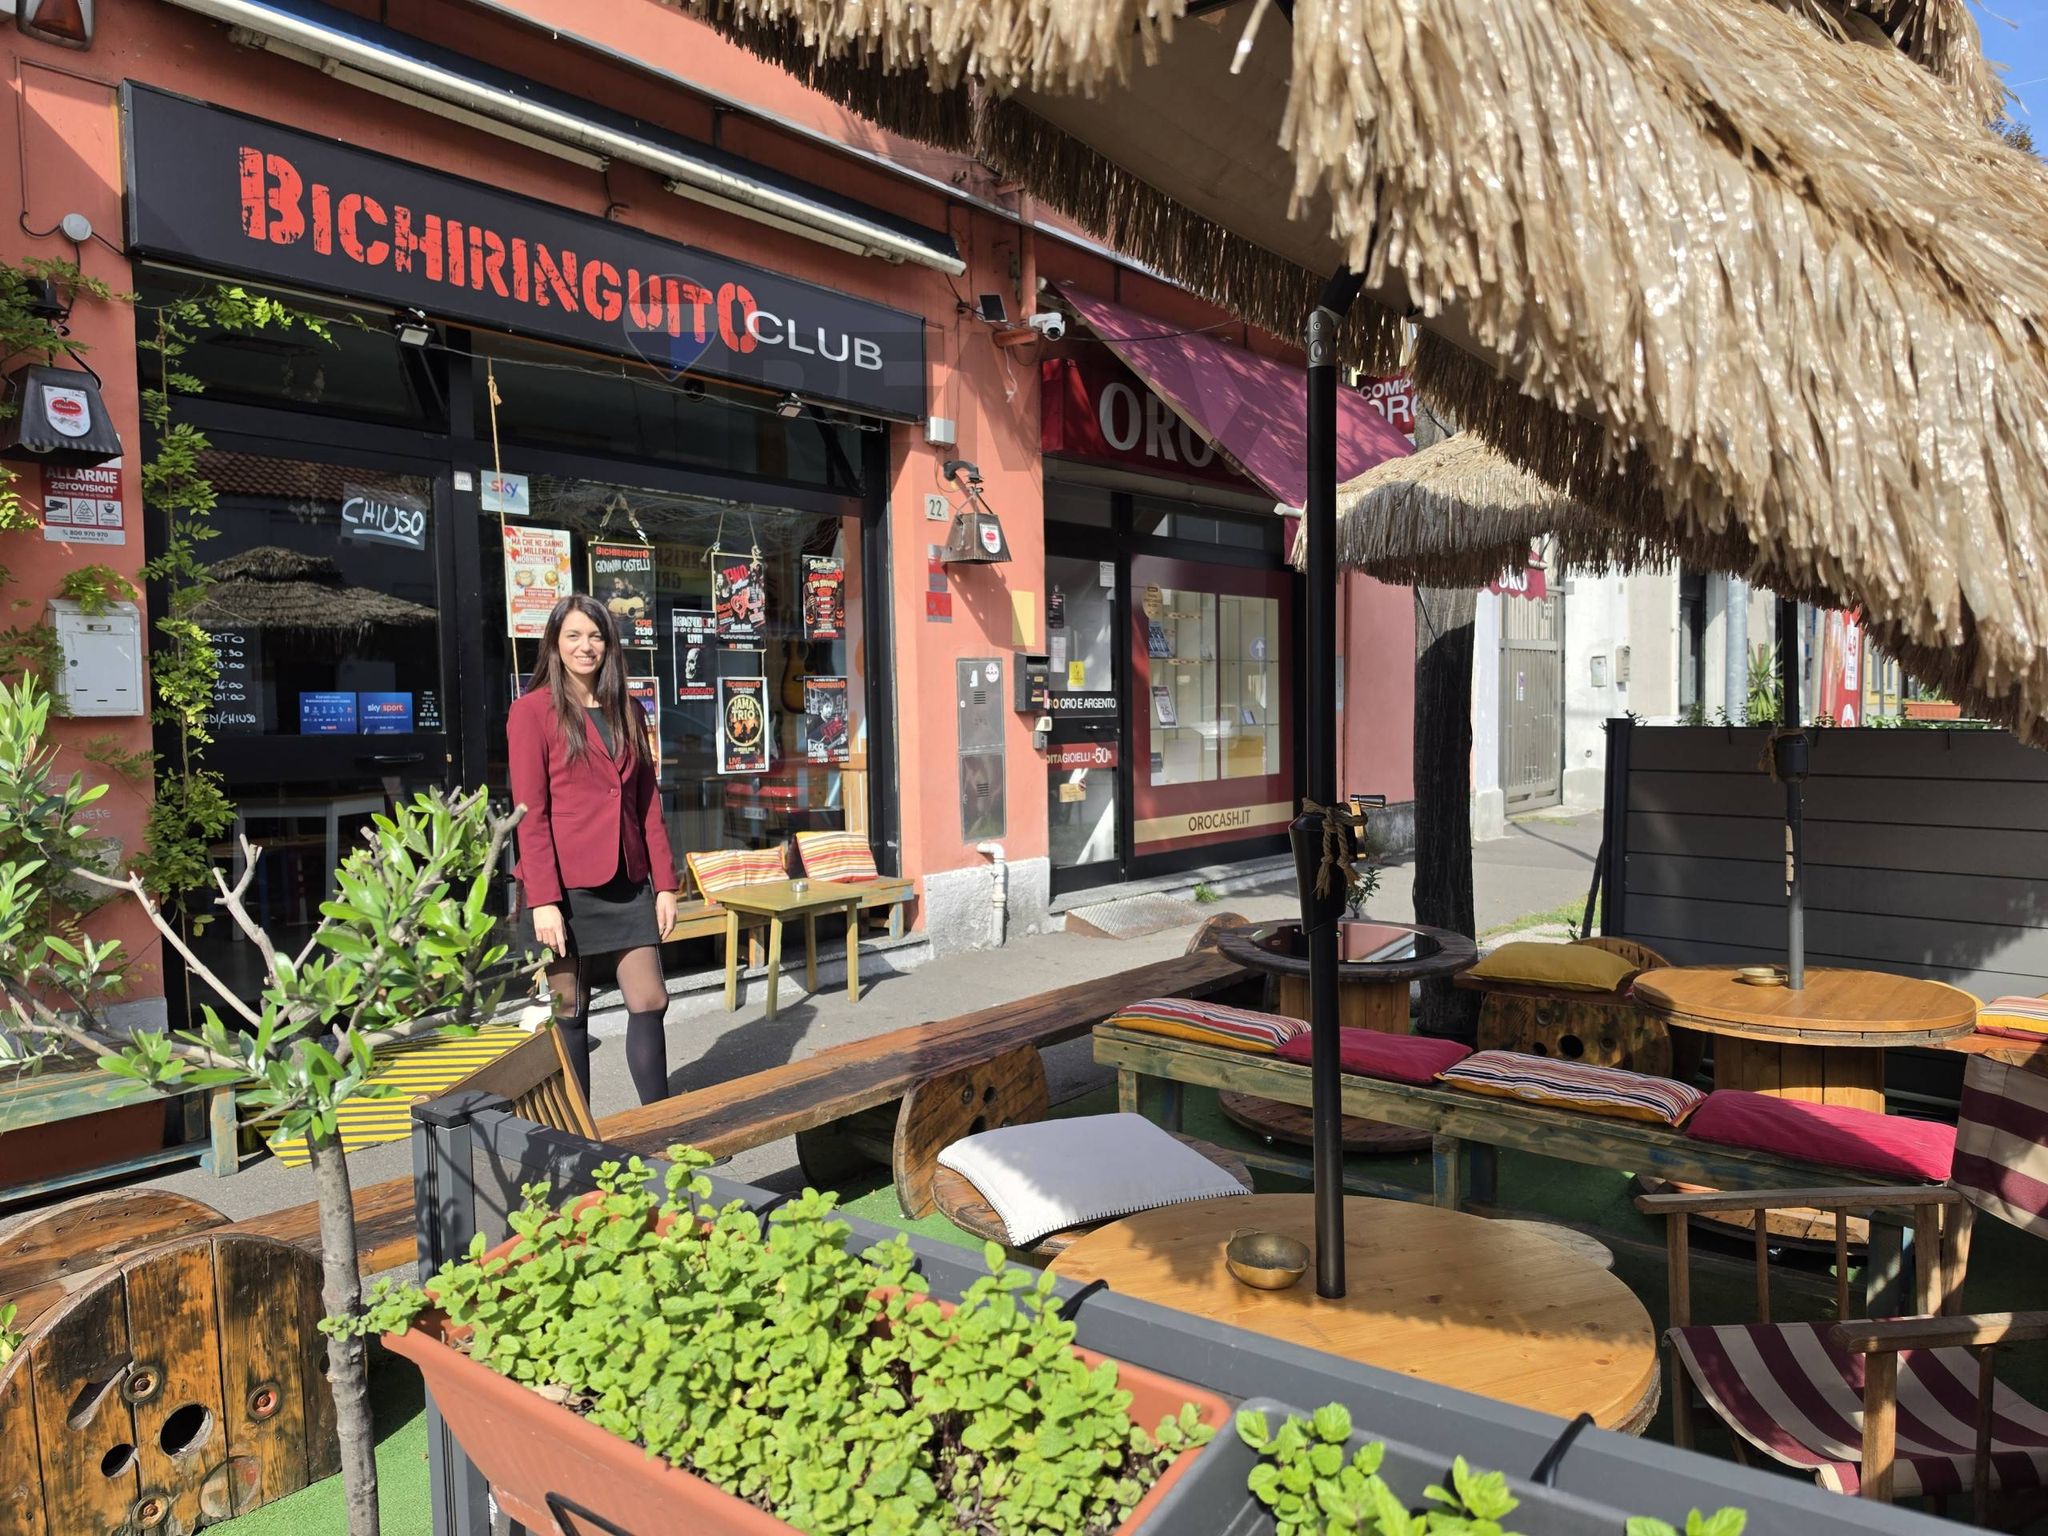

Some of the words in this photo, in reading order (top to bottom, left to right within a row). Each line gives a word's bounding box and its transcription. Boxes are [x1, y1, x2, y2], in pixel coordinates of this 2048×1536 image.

[746, 310, 884, 371] CLUB
[1360, 379, 1413, 400] COMP
[1100, 382, 1243, 476] ORO
[46, 467, 119, 484] ALLARME
[491, 479, 518, 497] sky
[929, 499, 942, 517] 22
[342, 497, 424, 537] CHIUSO
[212, 632, 246, 644] RTO
[213, 693, 247, 702] 01:00
[732, 698, 755, 710] JAMA
[1060, 698, 1077, 709] ORO
[1077, 698, 1083, 709] E
[1083, 697, 1117, 709] ARGENTO
[367, 704, 380, 713] sky
[382, 704, 403, 713] sport
[731, 710, 755, 721] TRIO
[1046, 753, 1062, 764] DITA
[1062, 752, 1091, 763] GIOIELLI
[1188, 809, 1252, 832] OROCASH.IT
